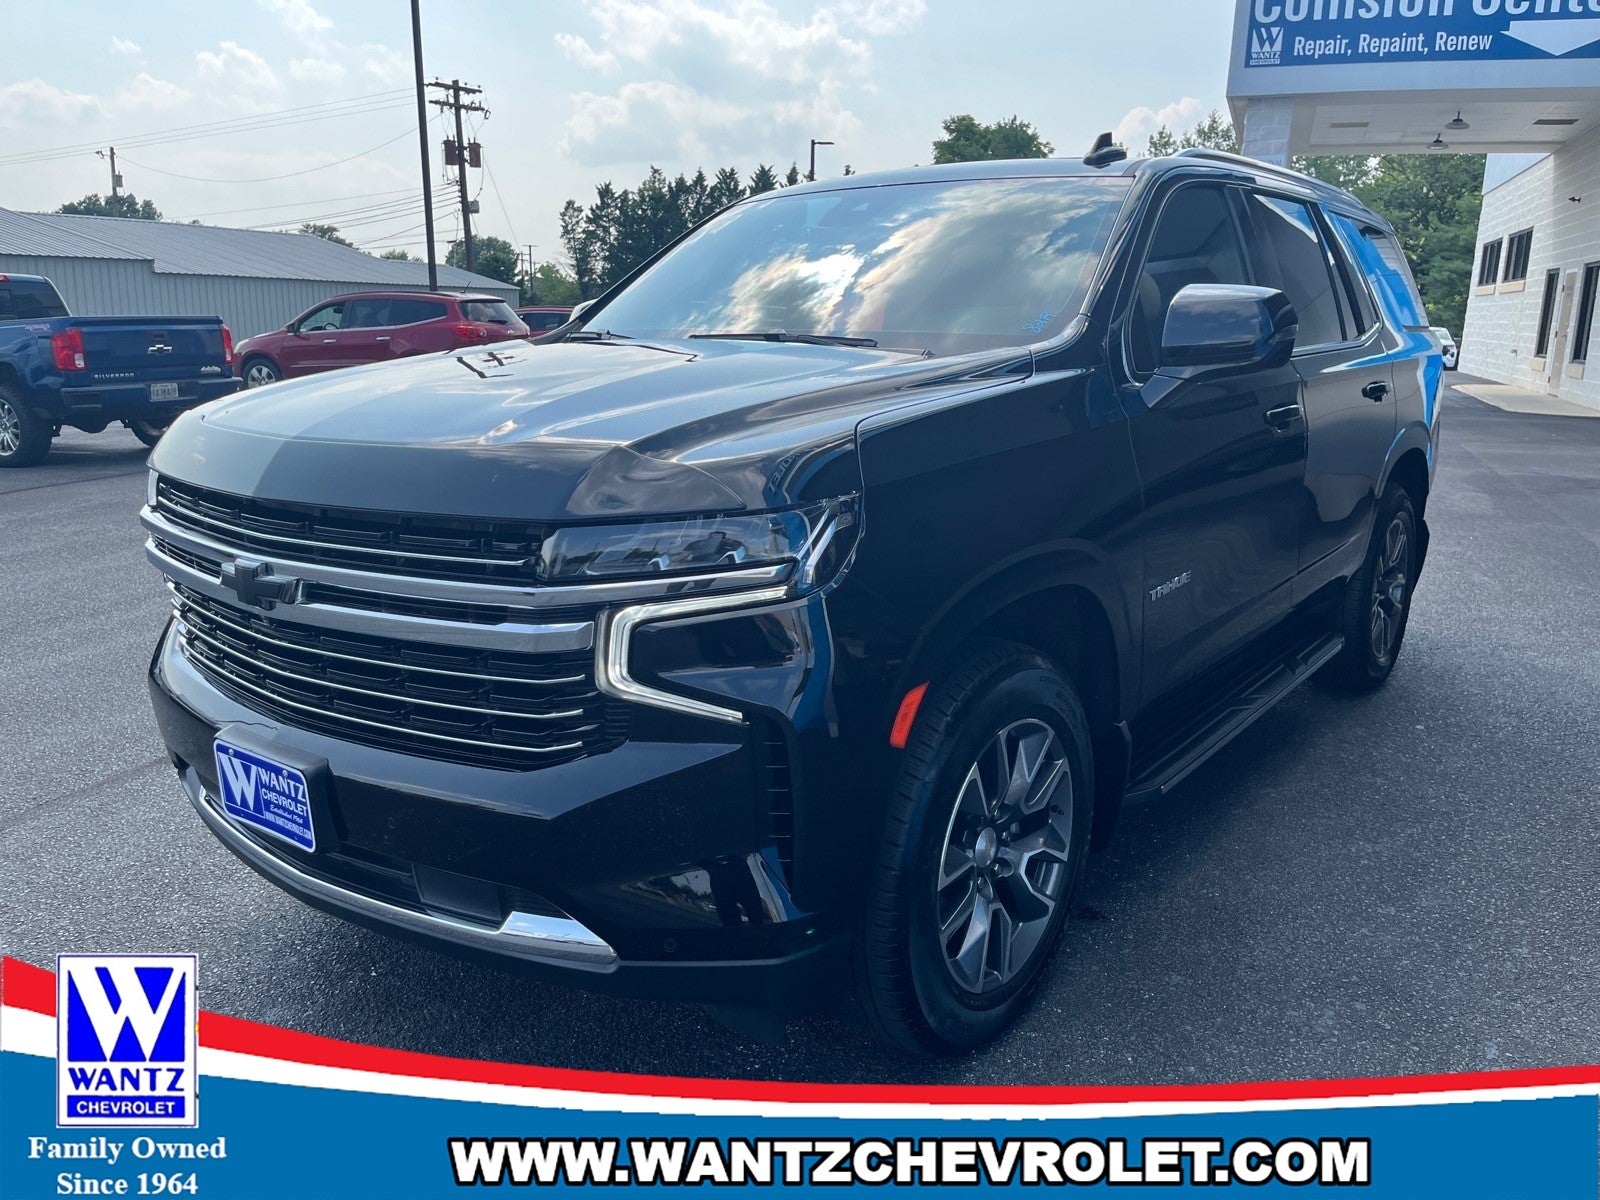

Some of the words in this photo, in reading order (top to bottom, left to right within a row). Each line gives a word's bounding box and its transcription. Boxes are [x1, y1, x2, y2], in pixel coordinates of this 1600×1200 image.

[1251, 51, 1280, 59] WANTZ
[1293, 35, 1352, 59] Repair,
[1358, 32, 1429, 57] Repaint,
[1435, 31, 1493, 51] Renew
[1149, 569, 1192, 601] TAHOE
[218, 753, 258, 812] W
[258, 767, 306, 803] WANTZ
[261, 787, 307, 817] CHEVROLET
